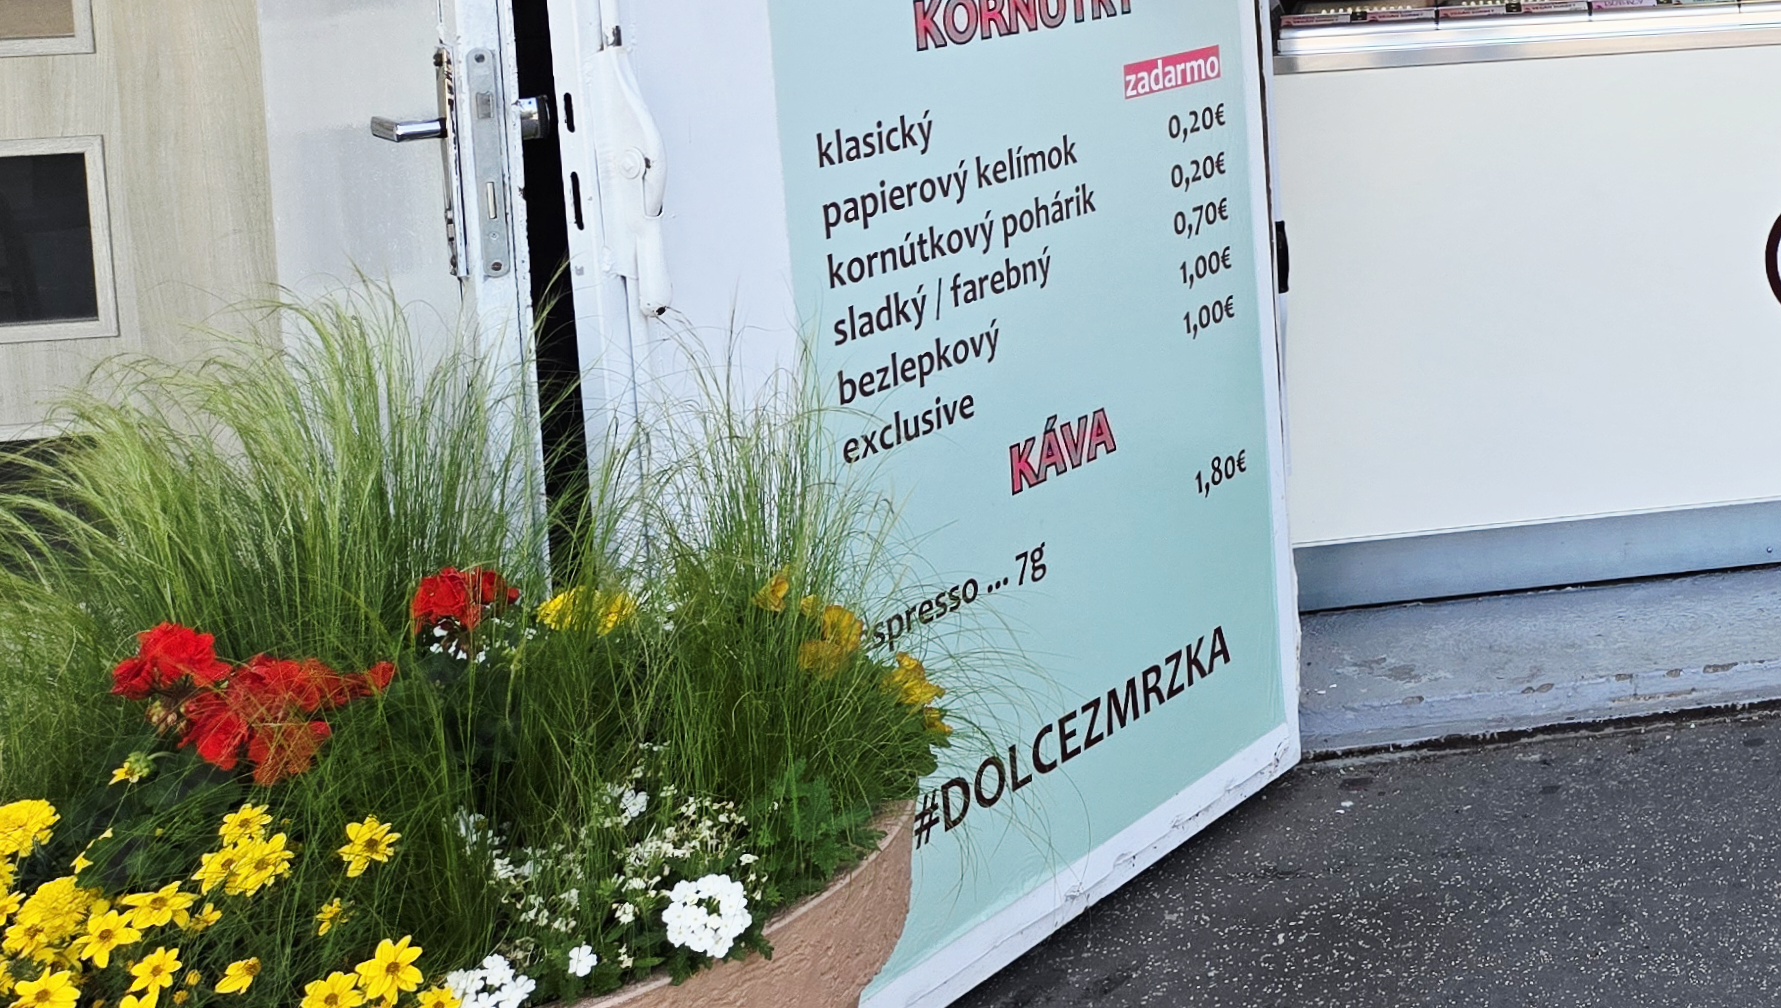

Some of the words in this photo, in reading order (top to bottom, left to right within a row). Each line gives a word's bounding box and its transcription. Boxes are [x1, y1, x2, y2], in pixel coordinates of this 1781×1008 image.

[1125, 53, 1220, 98] zadarmo
[815, 110, 933, 168] klasický
[1168, 103, 1226, 140] 0,20€
[822, 160, 968, 239] papierový
[976, 135, 1078, 189] kelímok
[1170, 152, 1227, 192] 0,20€
[826, 210, 995, 289] kornútkový
[1001, 183, 1096, 239] pohárik
[1173, 198, 1229, 238] 0,70€
[833, 289, 928, 346] sladký
[949, 247, 1051, 308] farebný
[1179, 246, 1233, 289] 1,00€
[1182, 295, 1236, 339] 1,00€
[837, 318, 1000, 405] bezlepkový
[843, 394, 976, 464] exclusive
[1009, 407, 1117, 495] KÁVA
[1194, 449, 1247, 498] 1,80€
[864, 578, 979, 653] spresso
[1015, 541, 1047, 586] 7g
[914, 625, 1231, 850] #DOLCEZMRZKA
